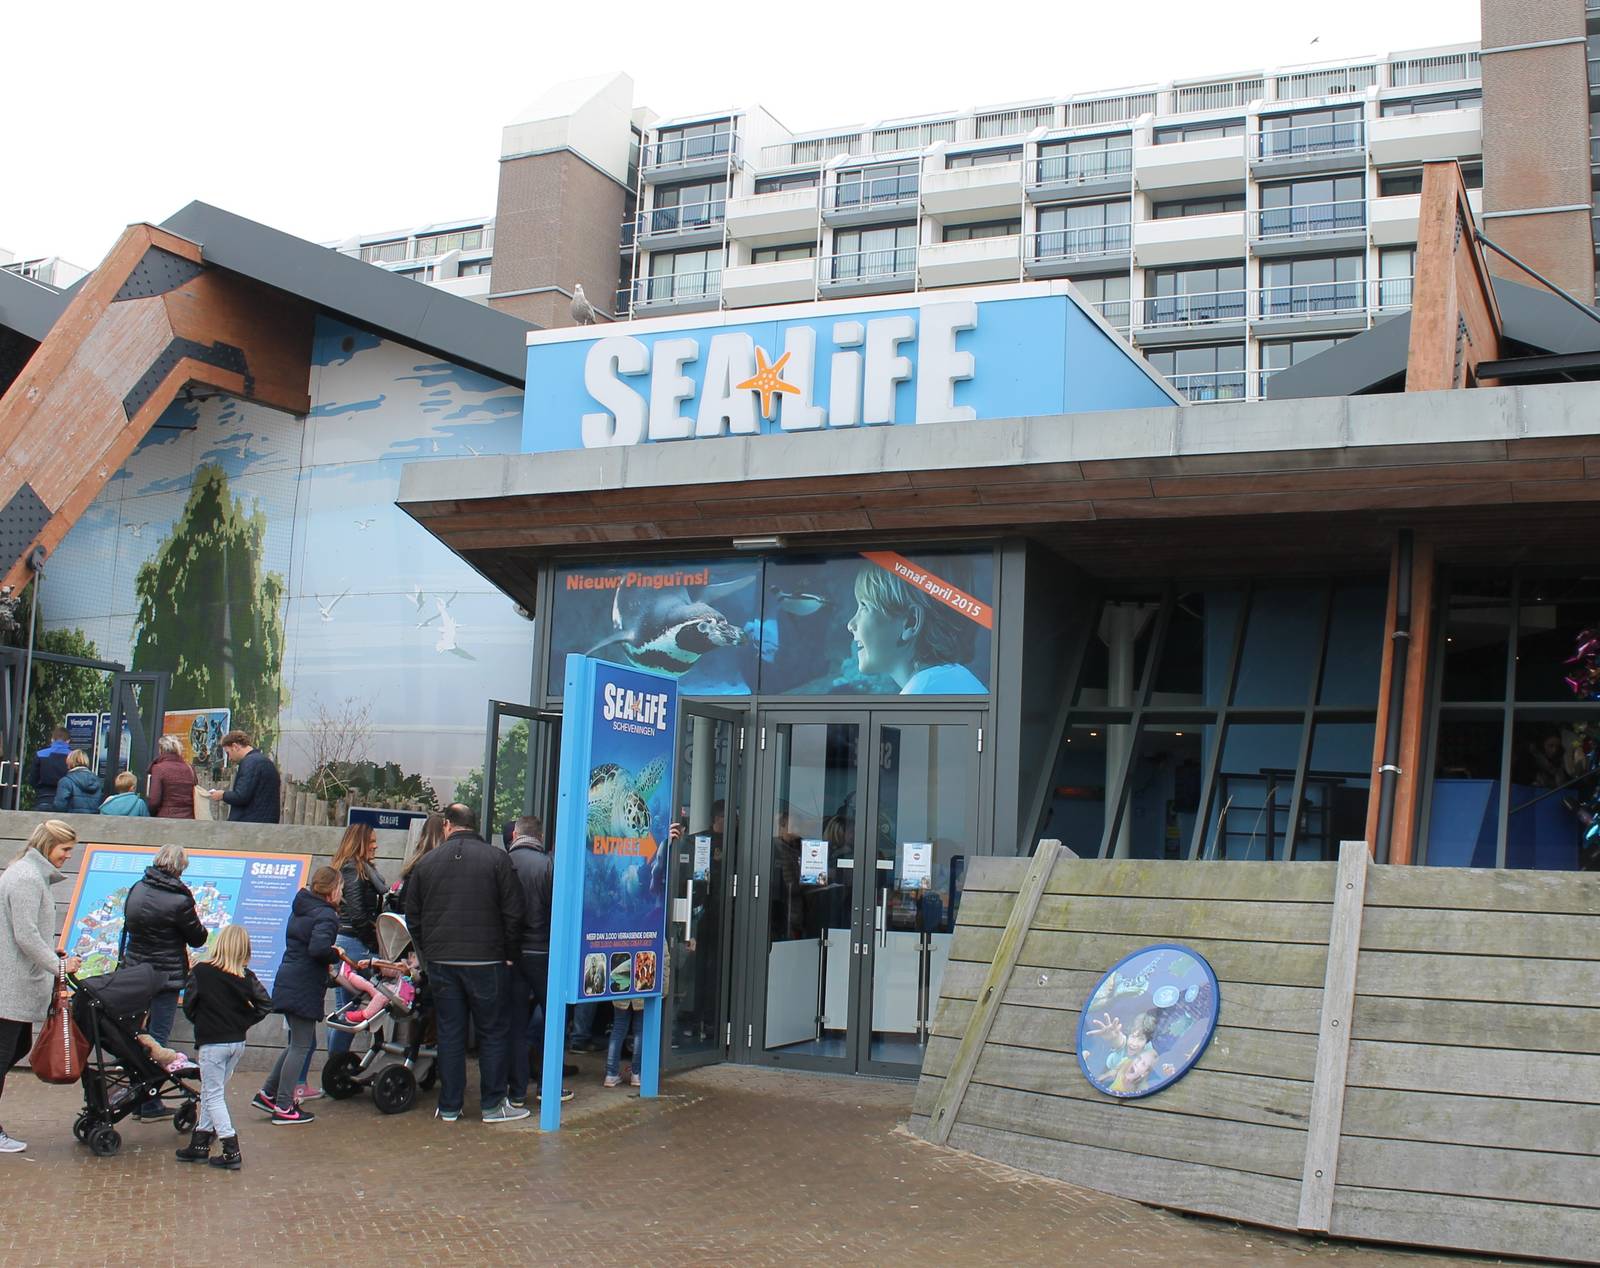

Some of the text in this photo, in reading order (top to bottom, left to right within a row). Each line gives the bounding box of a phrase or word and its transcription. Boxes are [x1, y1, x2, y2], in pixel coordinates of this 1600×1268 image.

[581, 332, 760, 449] SEA
[625, 568, 709, 589] Pinguïns!
[894, 562, 981, 617] vanaf april 2015
[603, 683, 633, 720] SEA
[612, 721, 655, 736] SCHEVENINGEN
[251, 862, 273, 875] SEA
